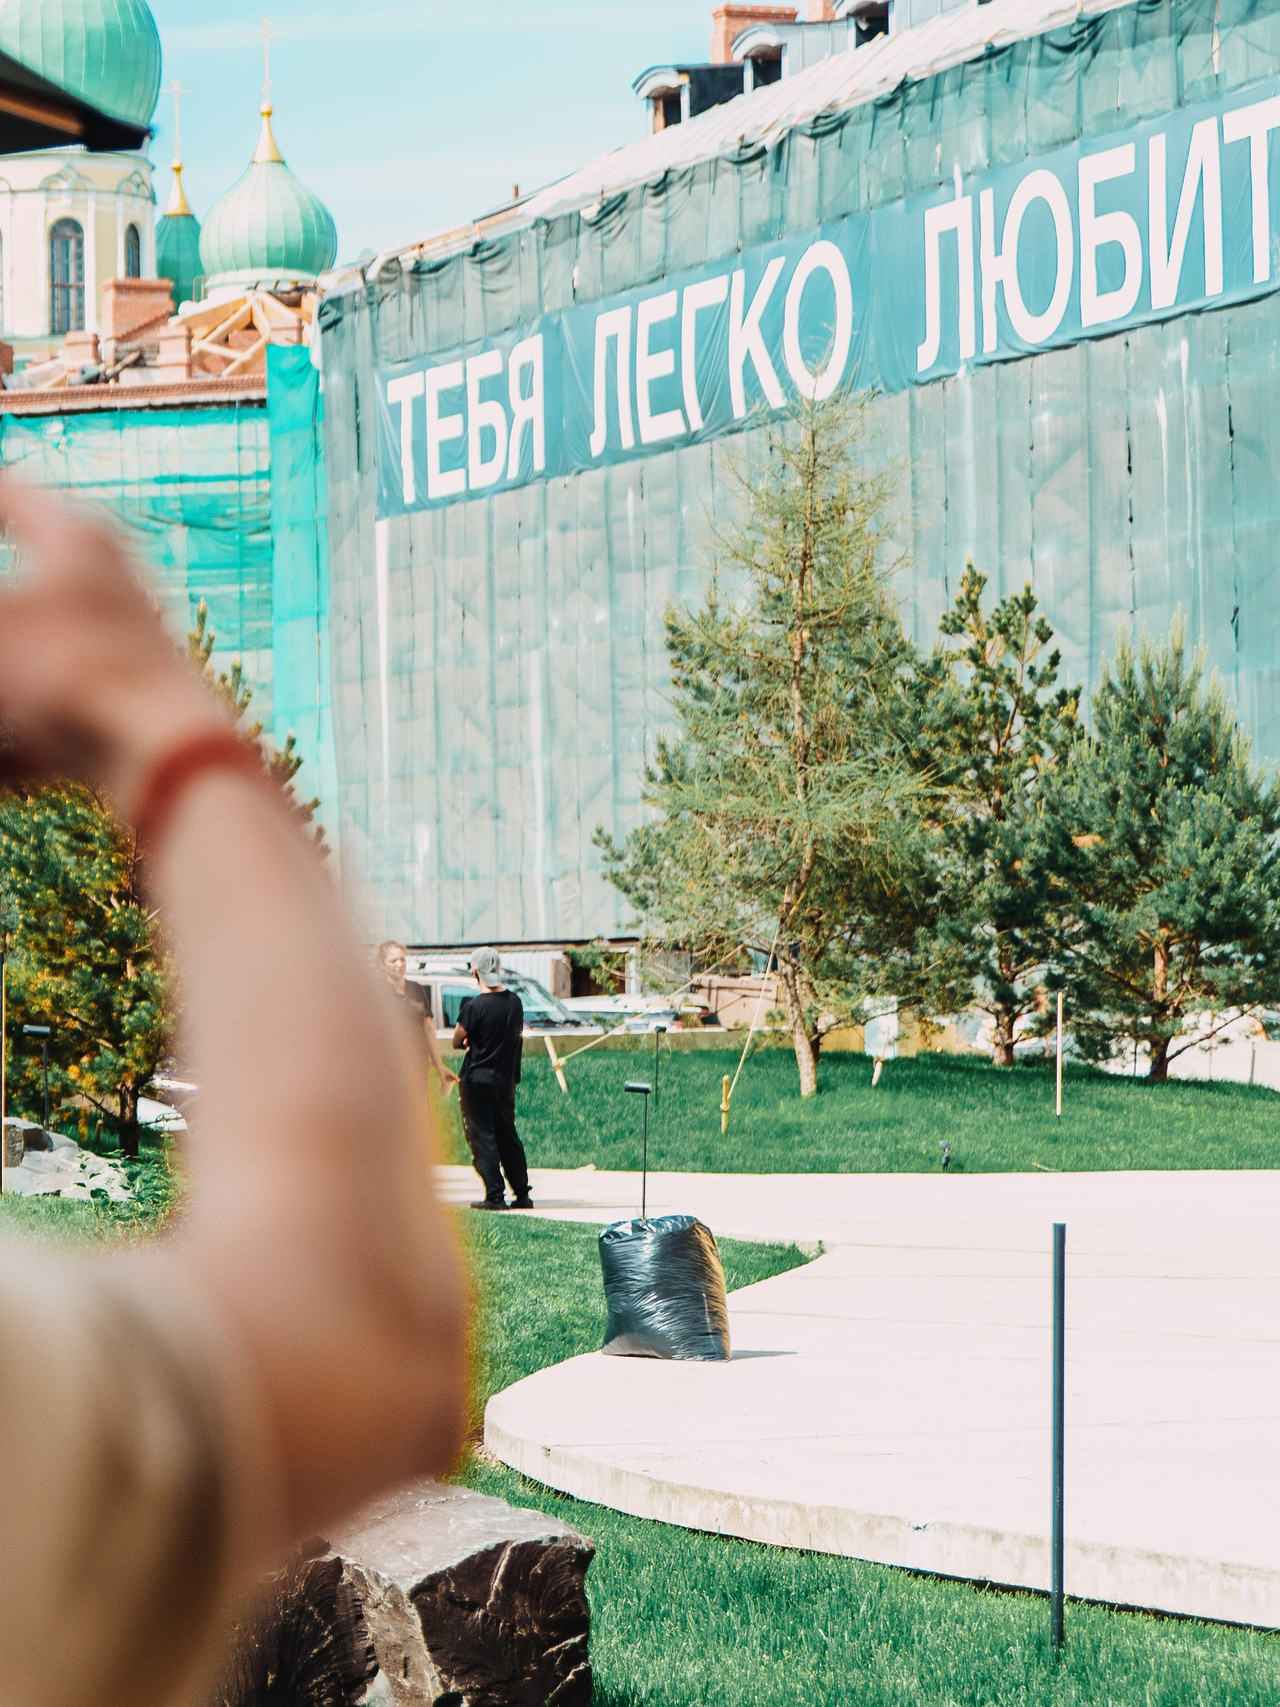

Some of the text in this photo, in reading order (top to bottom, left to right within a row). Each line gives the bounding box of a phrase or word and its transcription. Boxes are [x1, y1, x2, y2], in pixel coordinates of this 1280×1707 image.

[387, 95, 1280, 505] ТЕБЯ ЛЕГКО ЛЮБИТ
